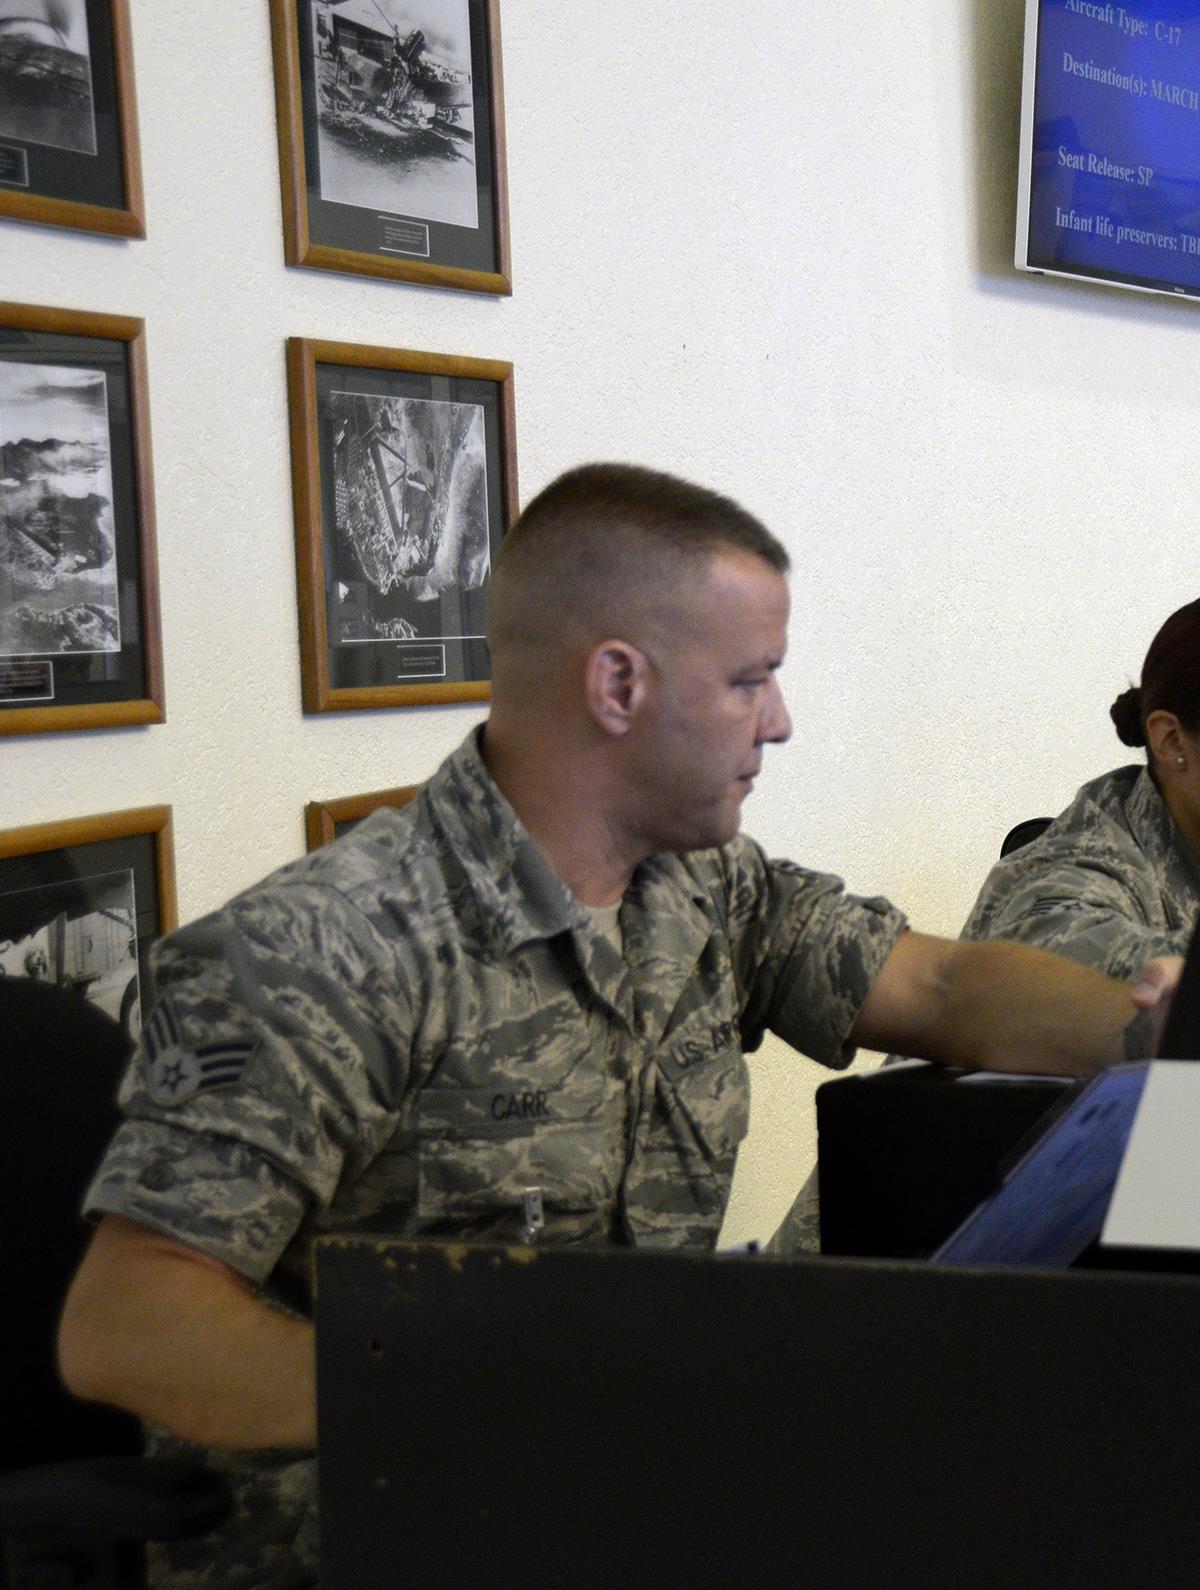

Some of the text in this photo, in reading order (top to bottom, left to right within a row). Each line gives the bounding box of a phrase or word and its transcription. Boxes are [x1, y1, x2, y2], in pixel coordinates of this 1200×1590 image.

[1065, 0, 1181, 46] Aircraft Type: C-17
[1062, 52, 1147, 97] Destination(s):
[1151, 79, 1199, 110] MARCH
[1058, 145, 1154, 187] Seat Release: SP
[1055, 207, 1093, 233] Infant
[1096, 215, 1114, 238] life
[1116, 225, 1178, 250] preservers:
[492, 1090, 549, 1120] CARR
